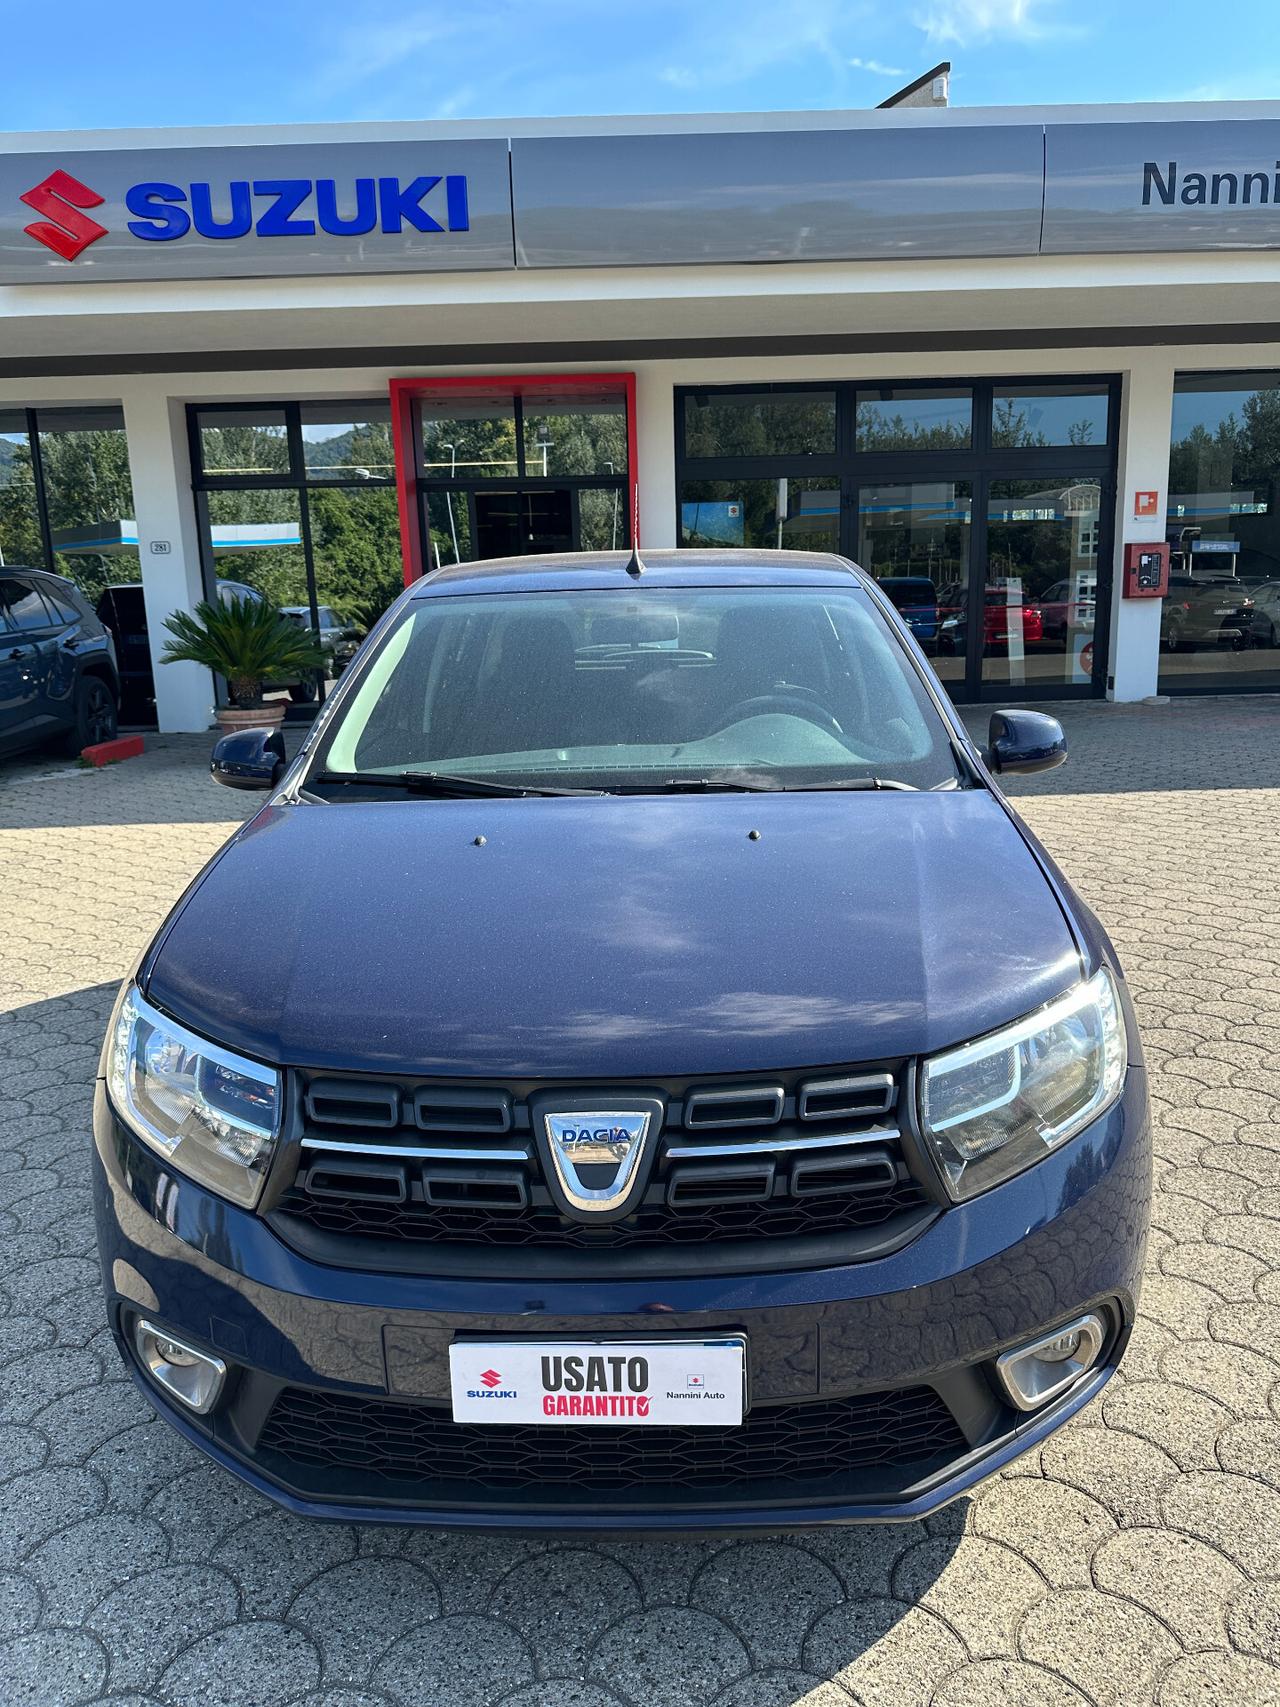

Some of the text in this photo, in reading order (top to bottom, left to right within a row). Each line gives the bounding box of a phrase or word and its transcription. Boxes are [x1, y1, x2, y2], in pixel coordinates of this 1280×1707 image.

[125, 175, 470, 241] SUZUKI
[562, 1128, 631, 1142] DACIA
[541, 1356, 649, 1392] USATO
[466, 1390, 517, 1398] SUZUKI
[666, 1391, 725, 1399] Nannini Auto
[543, 1395, 650, 1416] GARANTITO
